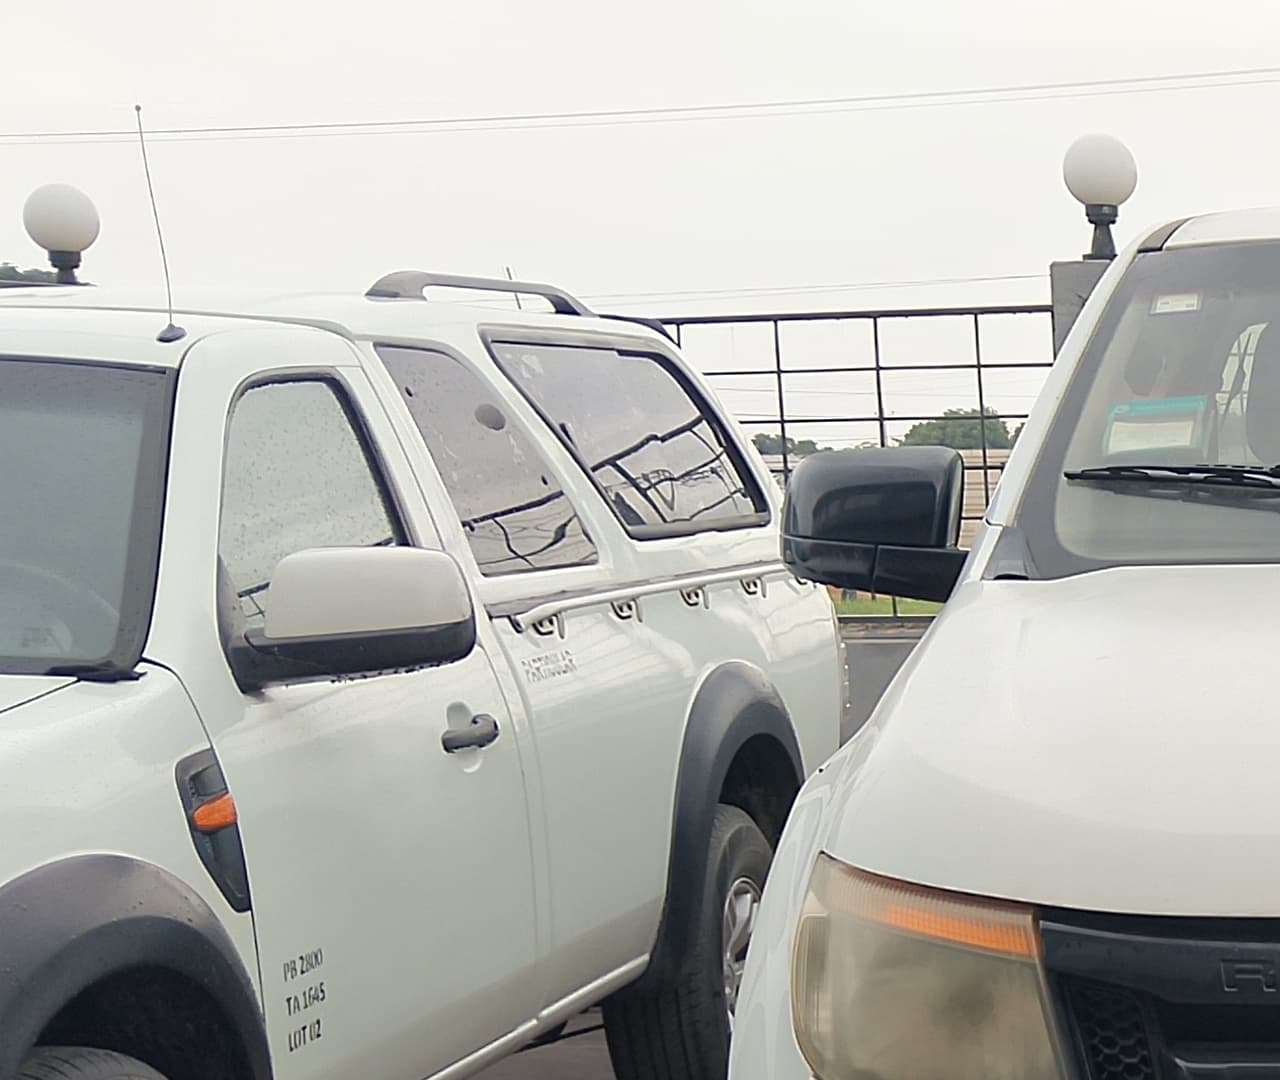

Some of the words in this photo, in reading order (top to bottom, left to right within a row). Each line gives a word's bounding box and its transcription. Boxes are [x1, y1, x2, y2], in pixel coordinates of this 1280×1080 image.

[283, 960, 298, 982] PB
[299, 948, 323, 975] 2800
[286, 995, 300, 1016] TA
[302, 981, 326, 1010] 1645
[288, 1024, 308, 1053] LOT
[309, 1018, 322, 1043] 02
